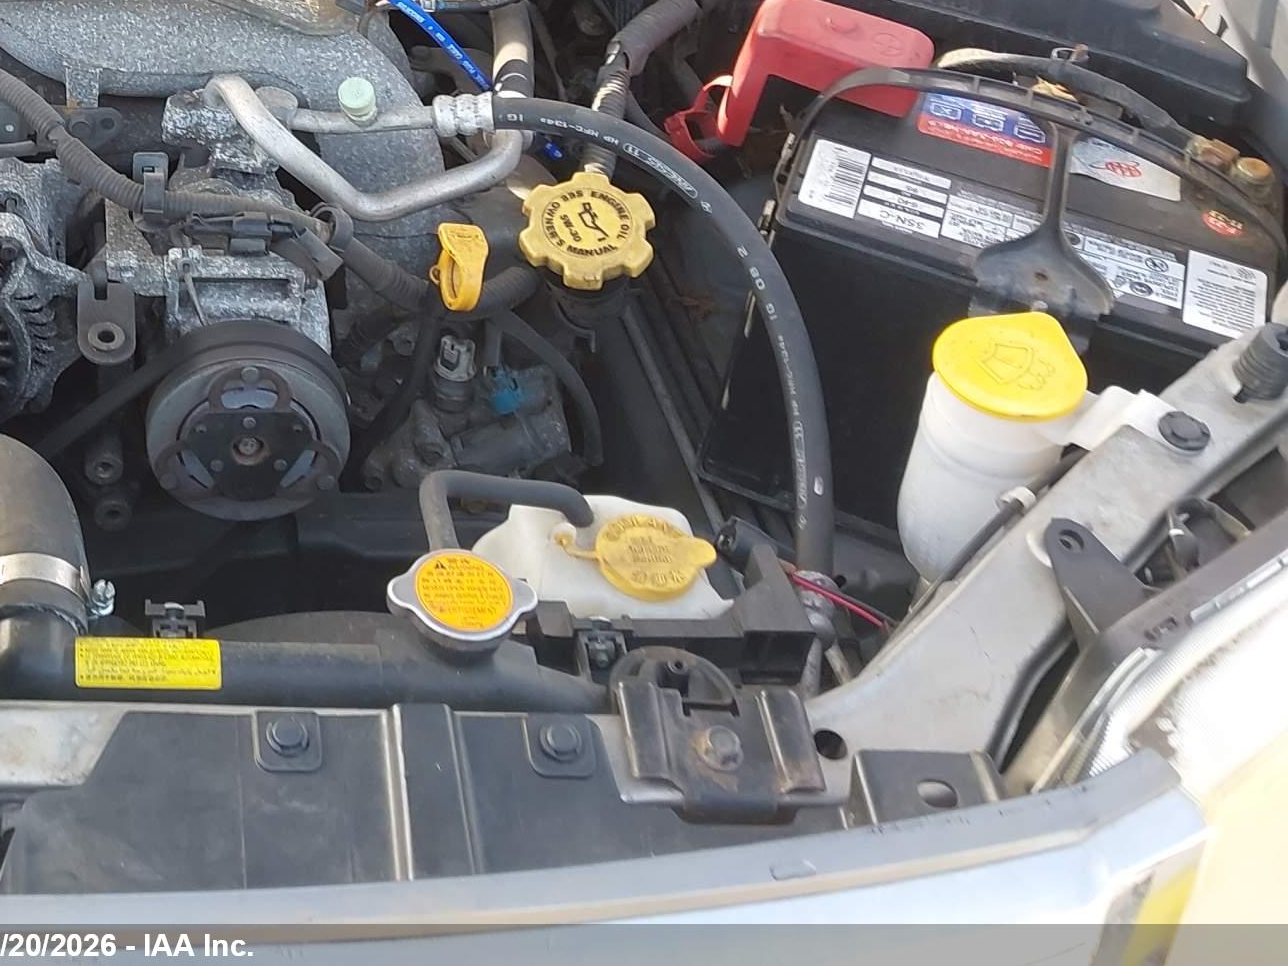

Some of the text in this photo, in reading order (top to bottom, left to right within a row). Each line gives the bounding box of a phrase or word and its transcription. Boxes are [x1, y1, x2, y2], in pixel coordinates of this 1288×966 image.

[560, 189, 584, 202] SEE
[590, 190, 631, 241] ENGINE OIL
[566, 243, 618, 258] MANUAL
